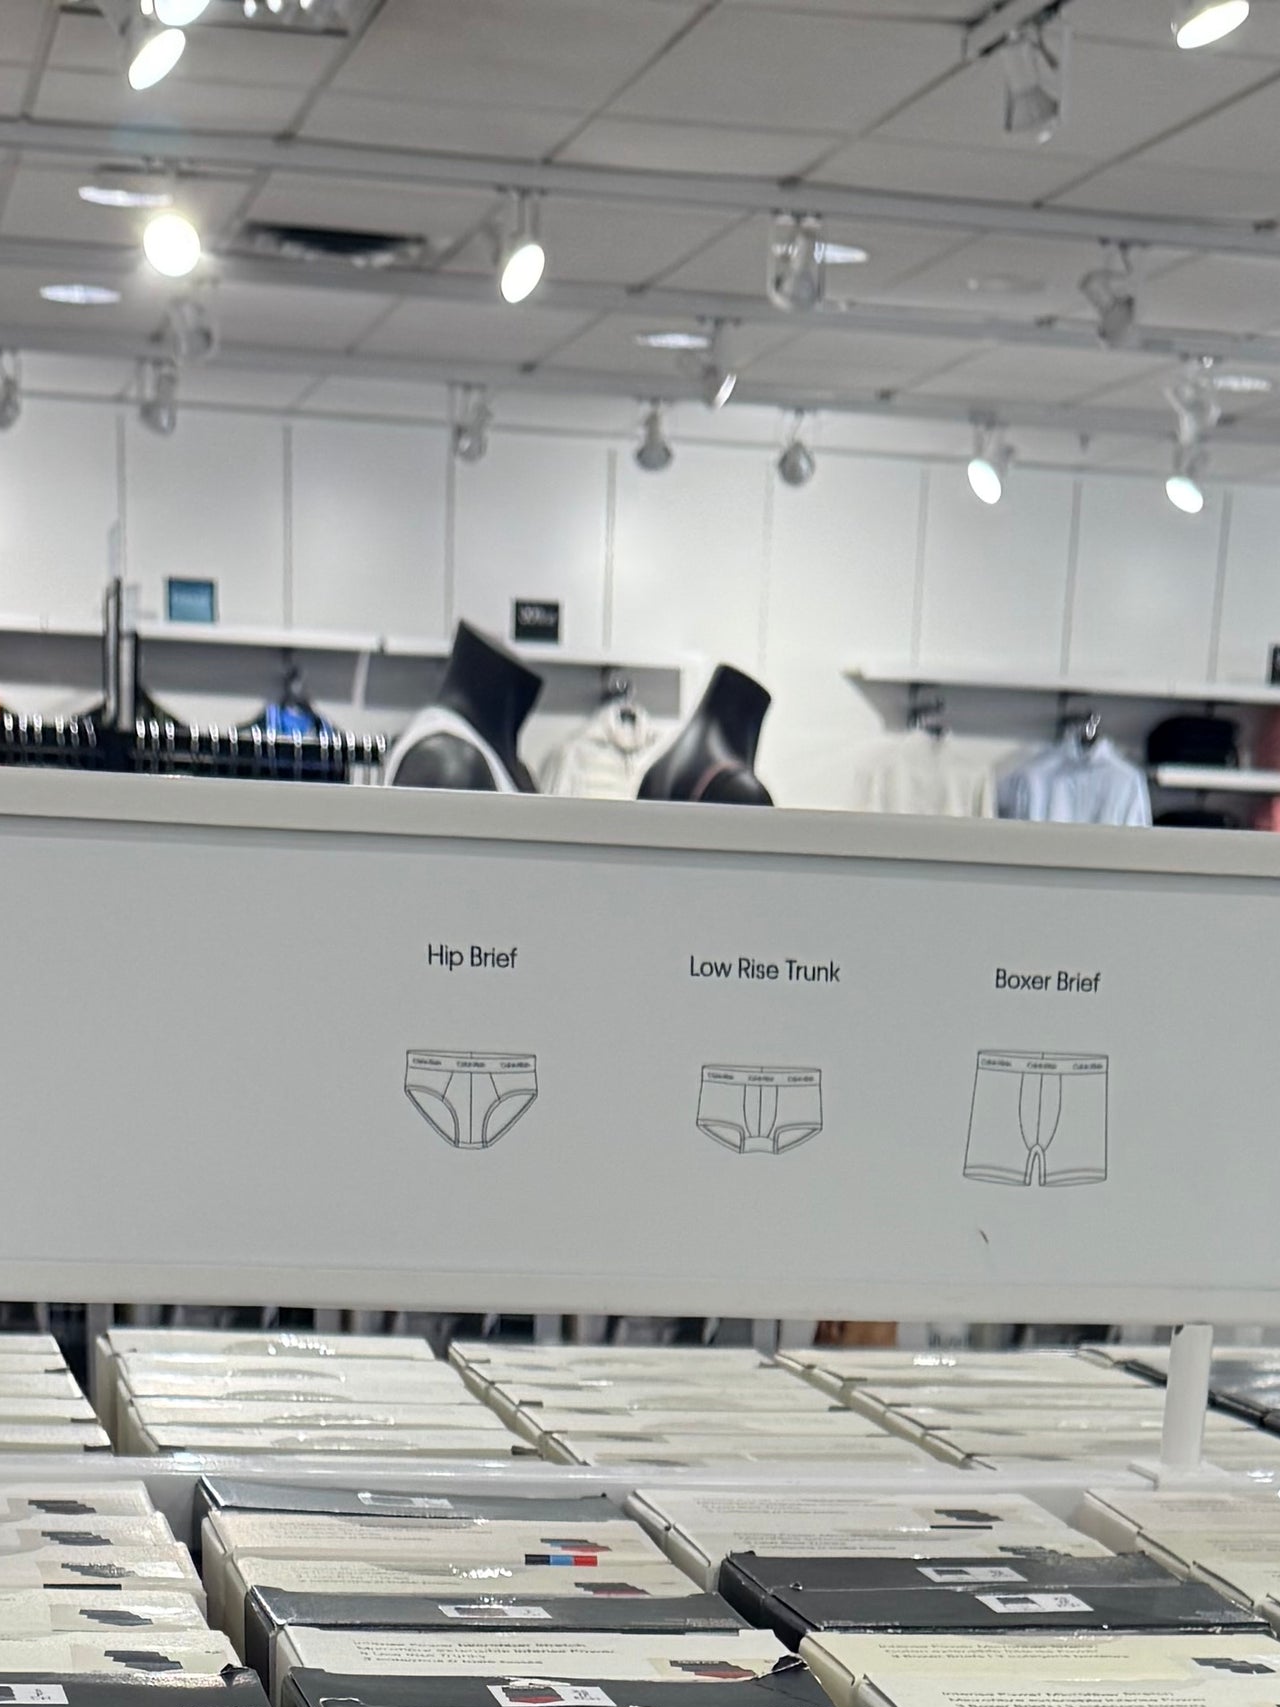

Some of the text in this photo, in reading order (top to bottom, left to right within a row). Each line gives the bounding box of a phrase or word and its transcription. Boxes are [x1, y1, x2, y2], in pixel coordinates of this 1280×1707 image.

[427, 943, 518, 972] Hip Brief
[690, 954, 841, 983] Low Rise Trunk
[995, 968, 1101, 993] Boxer Brief
